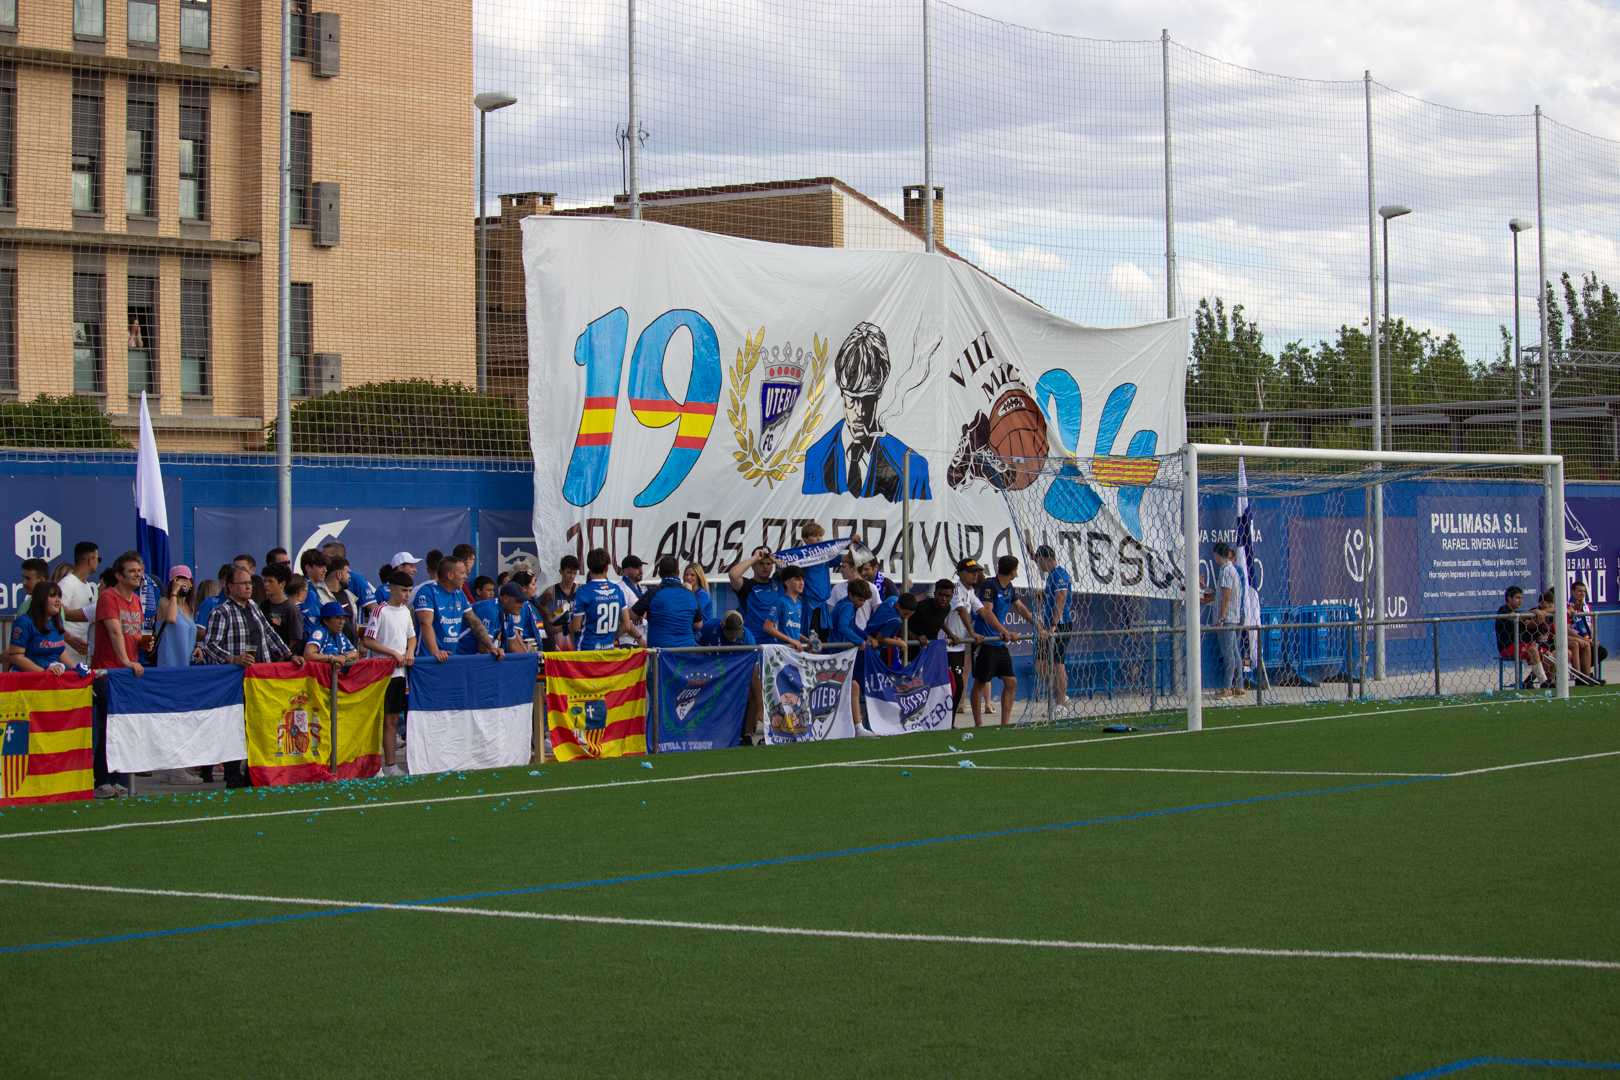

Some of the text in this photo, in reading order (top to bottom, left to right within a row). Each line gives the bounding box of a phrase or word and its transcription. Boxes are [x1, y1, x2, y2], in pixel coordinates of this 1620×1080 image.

[561, 306, 722, 508] 19
[765, 387, 798, 418] UTEBO
[1431, 513, 1527, 533] PULIMASA S.L.
[1442, 538, 1518, 550] RAFAEL RIVERA VALLE
[1567, 558, 1606, 569] OSADA DEL
[1567, 570, 1607, 603] ONO
[596, 602, 620, 634] 20
